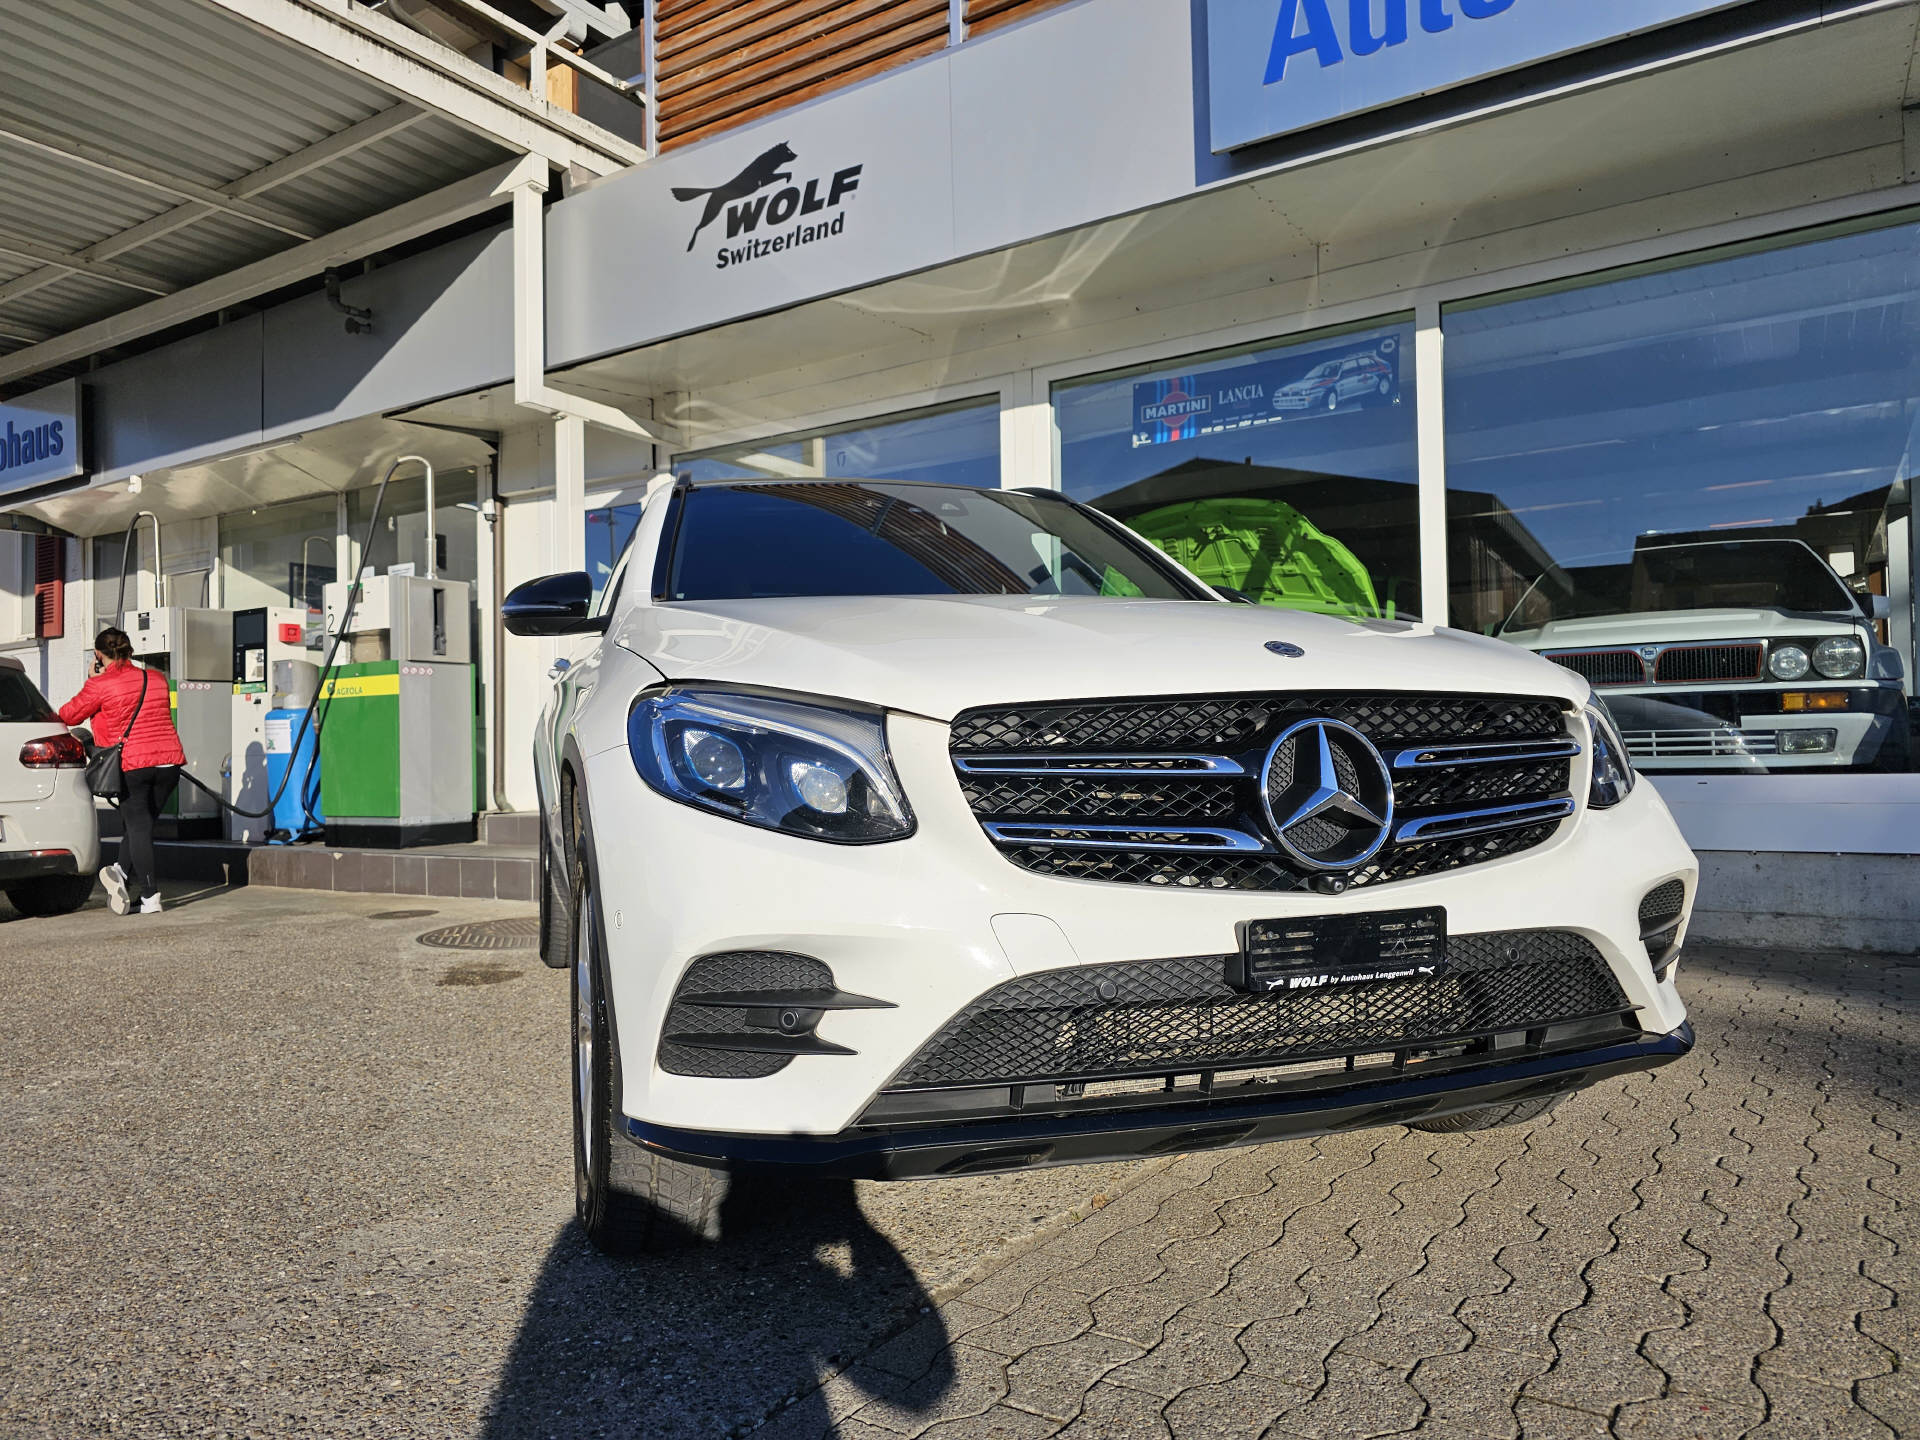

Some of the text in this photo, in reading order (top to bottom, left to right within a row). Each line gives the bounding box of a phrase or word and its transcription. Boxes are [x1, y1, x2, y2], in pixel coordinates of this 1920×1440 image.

[726, 163, 864, 239] WOLF
[715, 211, 846, 270] Switzerland
[1218, 384, 1264, 405] LANCIA
[1145, 398, 1207, 420] MARTINI
[327, 613, 335, 633] 2
[1289, 975, 1329, 989] WOLF
[1330, 975, 1340, 984] by
[1340, 972, 1374, 981] Autohaus
